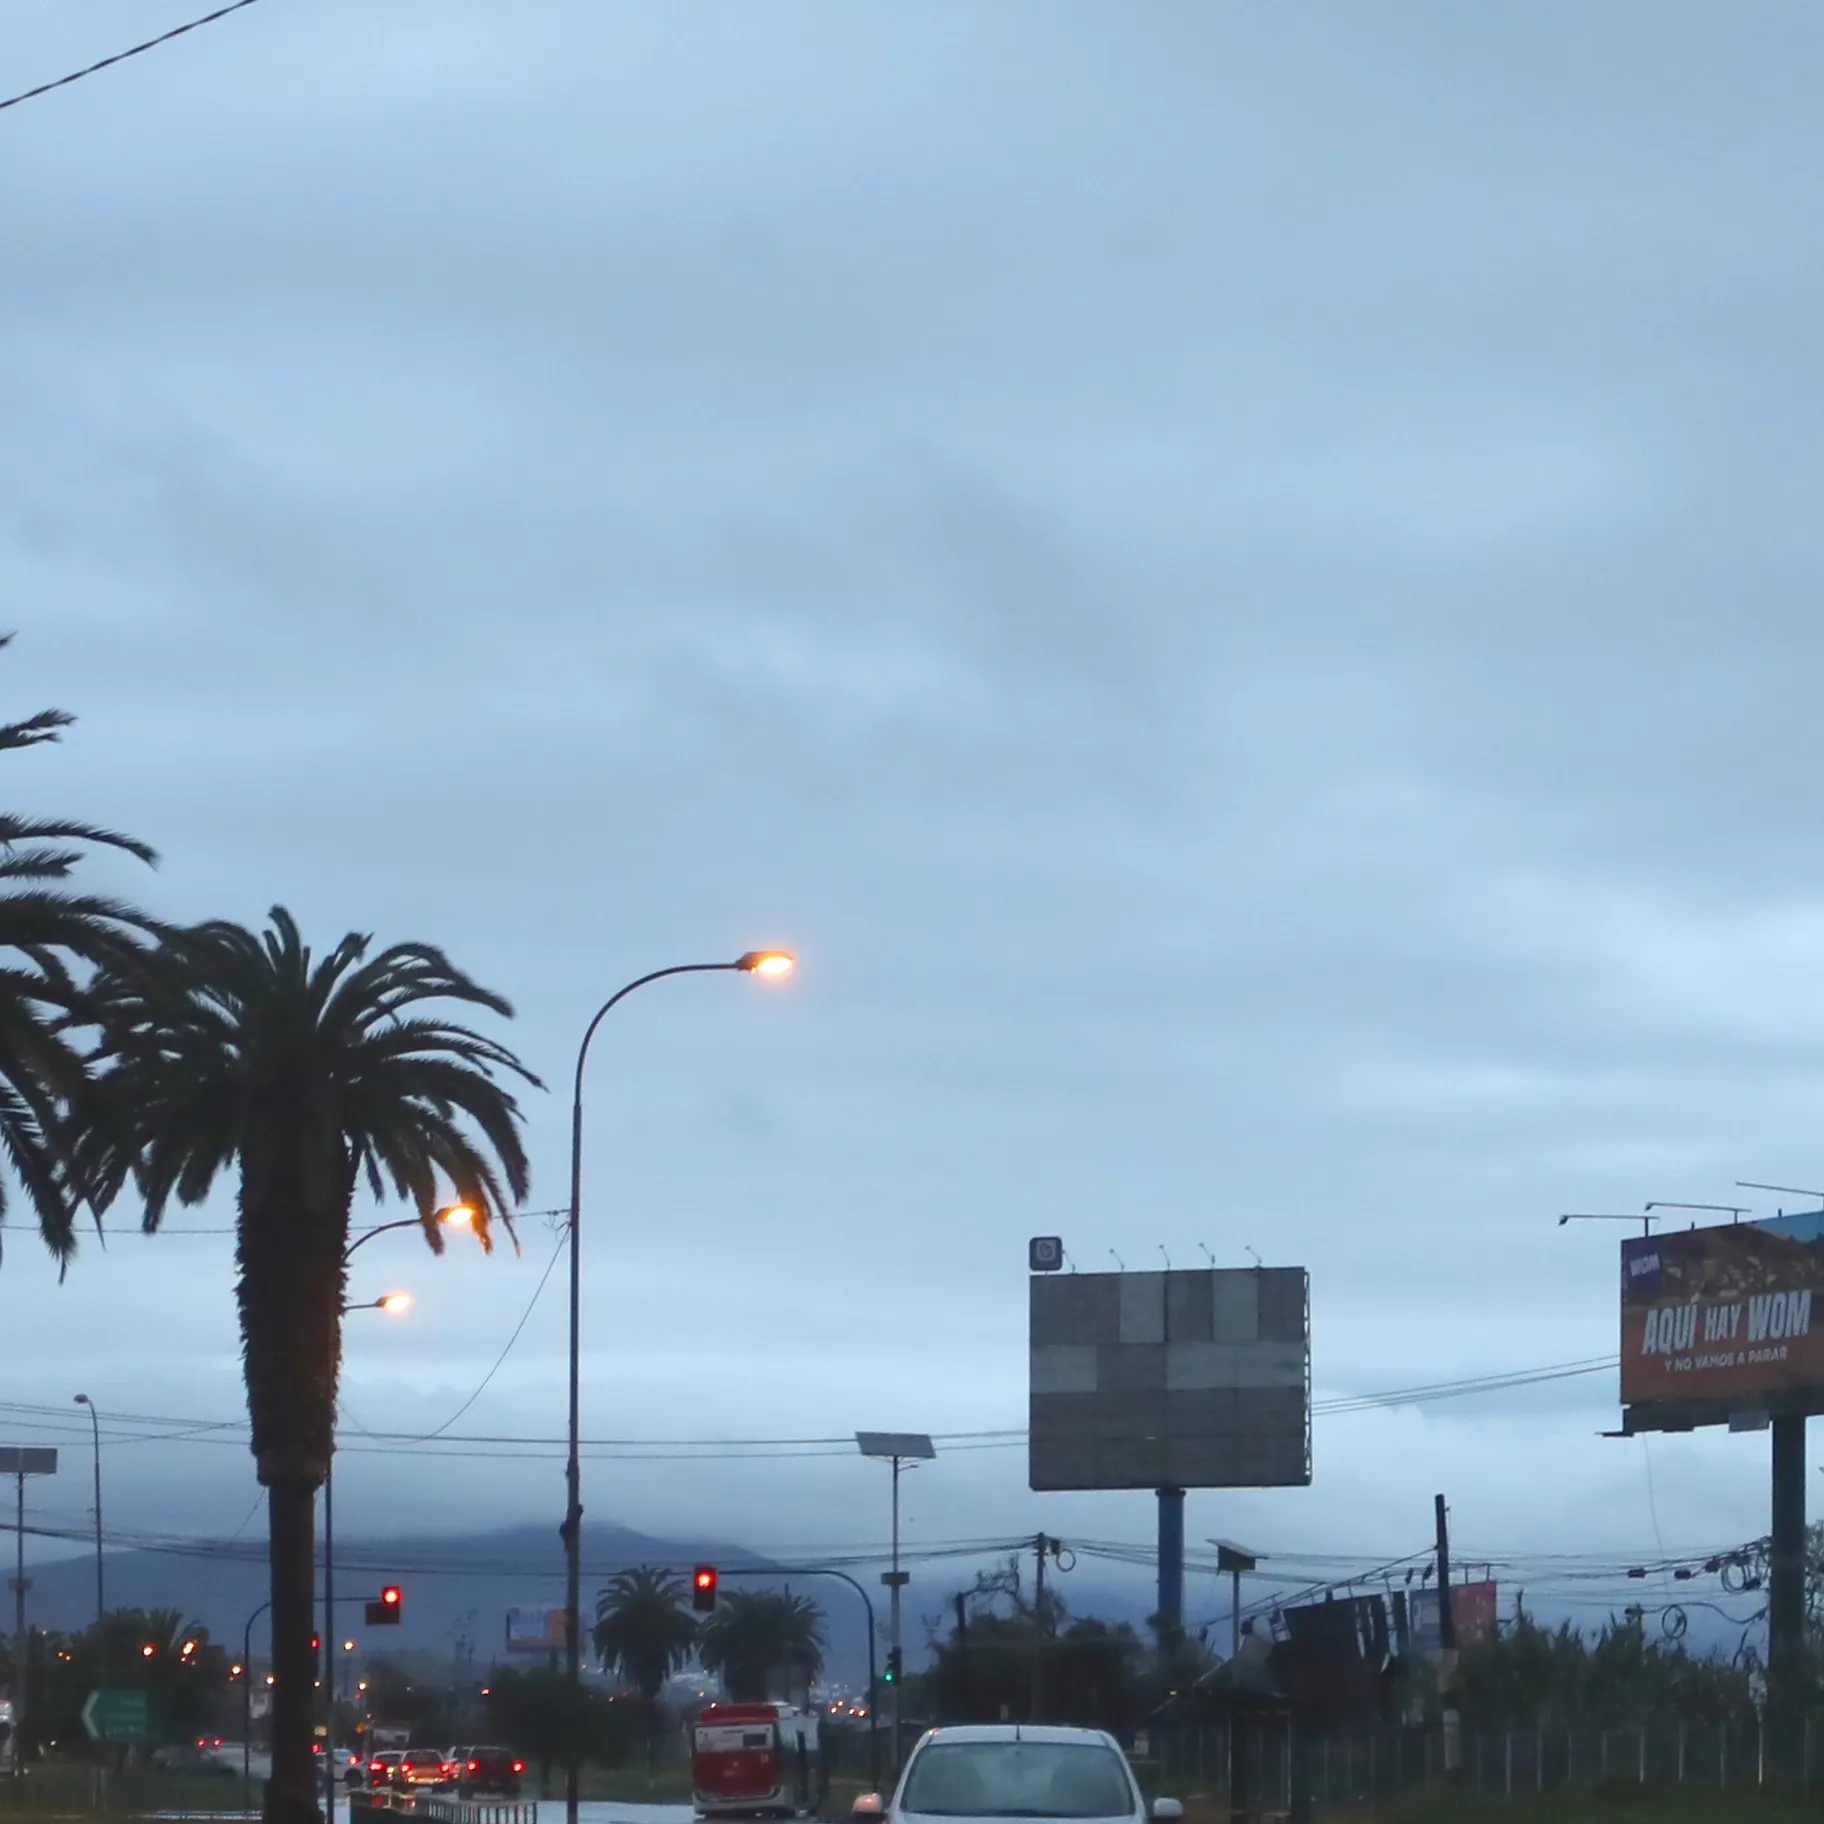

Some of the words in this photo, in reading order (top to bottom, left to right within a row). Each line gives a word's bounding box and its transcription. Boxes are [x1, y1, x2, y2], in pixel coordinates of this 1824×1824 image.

[1642, 1293, 1701, 1355] AQUÍ
[1704, 1306, 1742, 1341] HAY
[1748, 1290, 1812, 1341] WOM
[1664, 1359, 1673, 1373] Y
[1674, 1357, 1693, 1371] NO
[1695, 1353, 1734, 1369] VAMOS
[1736, 1352, 1746, 1365] A
[1747, 1346, 1788, 1365] PARAR
